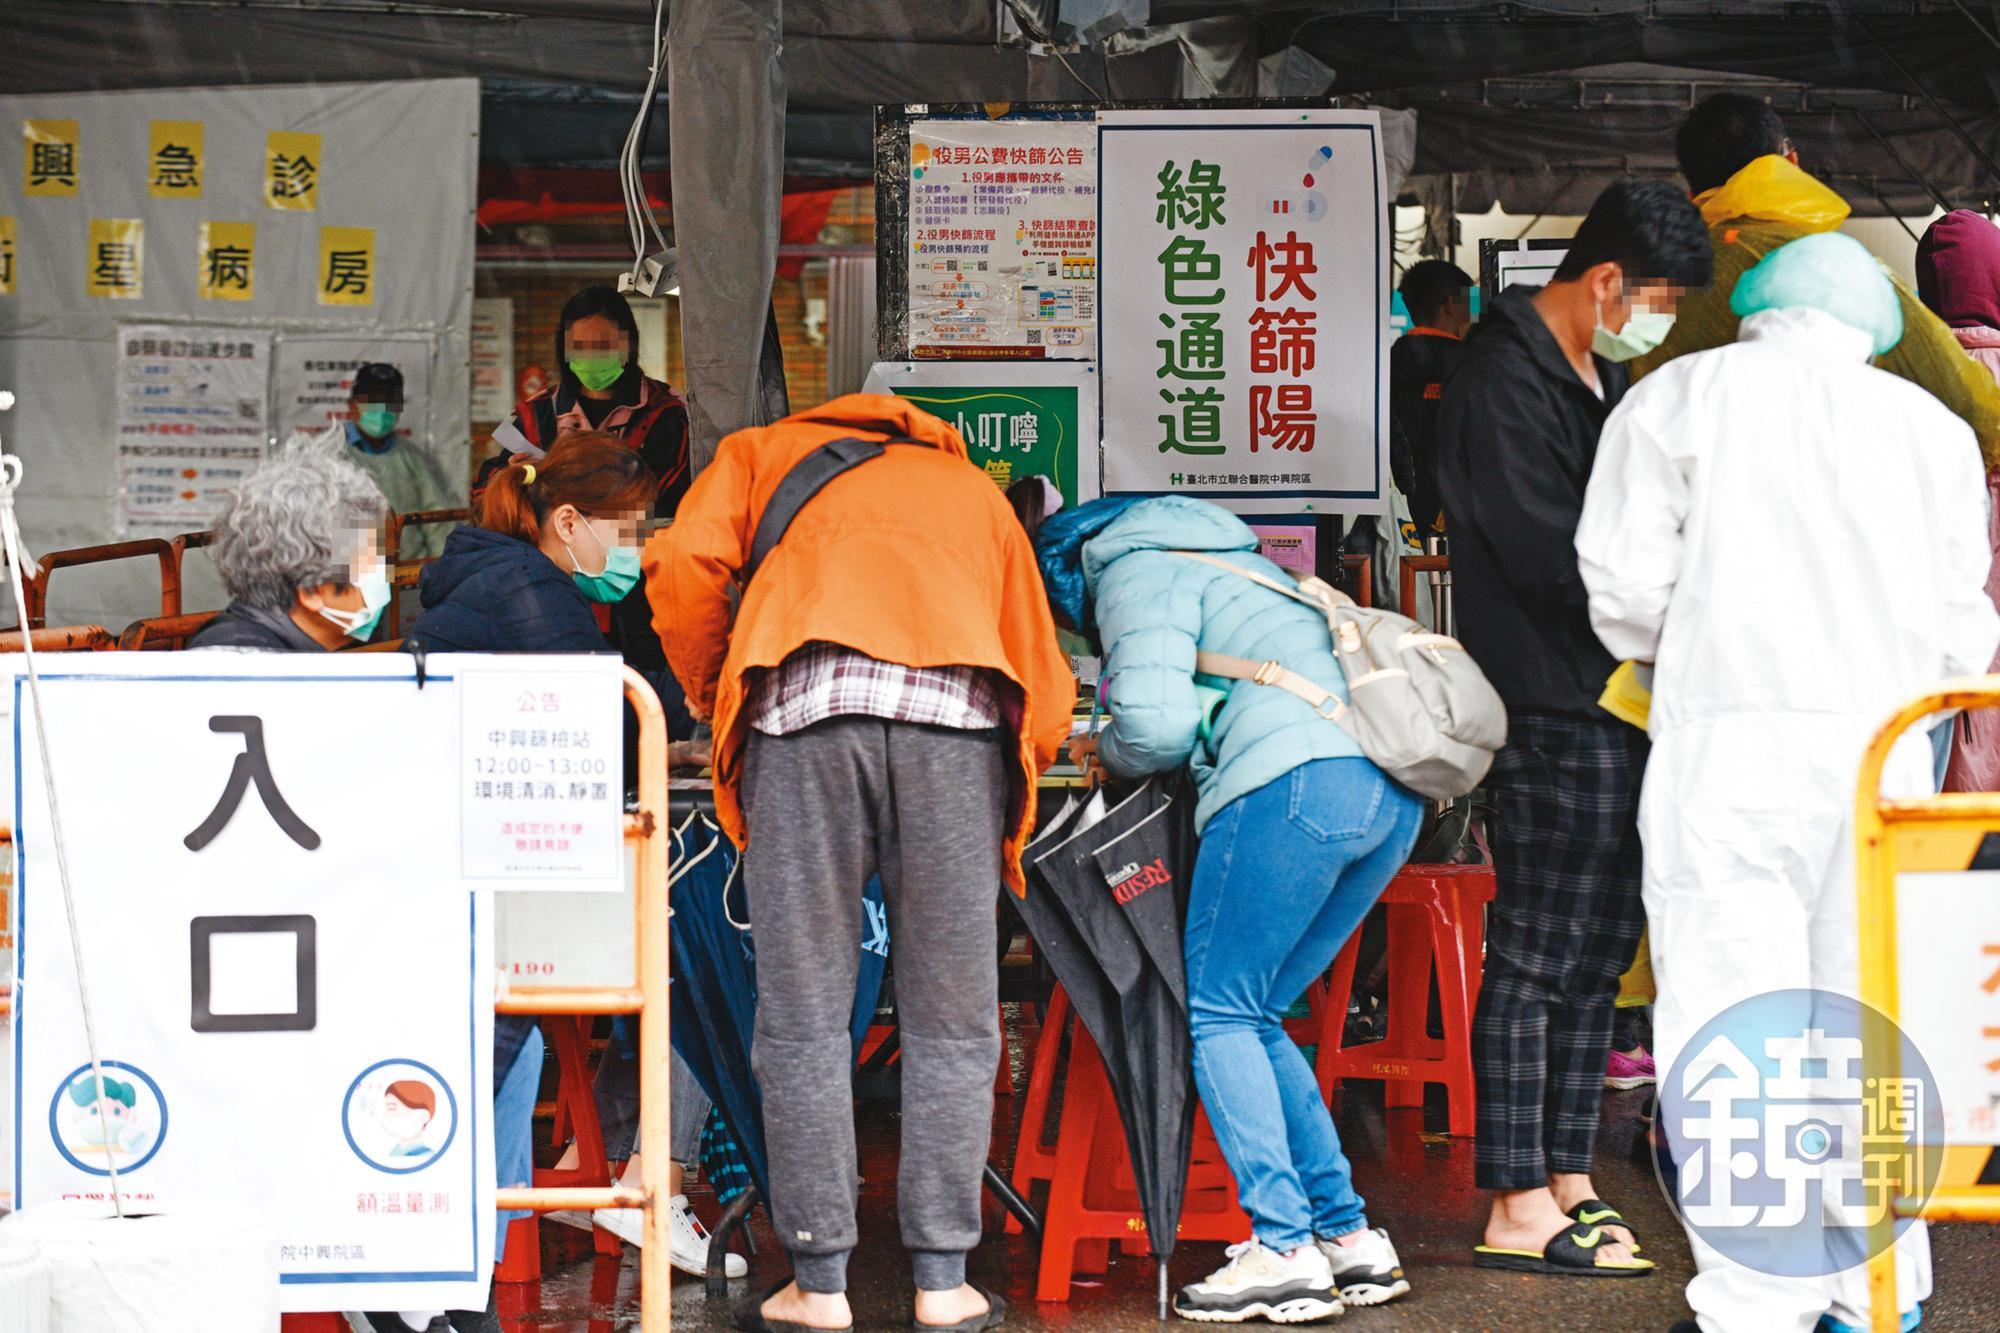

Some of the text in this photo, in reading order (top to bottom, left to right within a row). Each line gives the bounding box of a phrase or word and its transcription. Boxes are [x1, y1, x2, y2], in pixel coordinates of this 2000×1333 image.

[935, 147, 1084, 166] 役男公費快篩公告
[31, 142, 316, 199] 興急診
[962, 172, 1064, 184] 1.役男應攜帶的文件
[917, 229, 996, 241] 2.役男快篩流程
[920, 244, 989, 254] 役男快篩預約流程
[0, 239, 370, 295] 星病房
[1156, 159, 1227, 456] 綠色通道
[1247, 231, 1318, 454] 快篩陽
[951, 411, 1039, 453] 小叮嚀
[1186, 472, 1312, 485] 臺北市立聯合醫院中興院區
[517, 691, 560, 712] 公告
[488, 729, 591, 748] 中興篩檢站
[183, 715, 322, 1033] 入口
[357, 1192, 450, 1214] 額溫量測
[281, 1244, 366, 1261] 院中興院區
